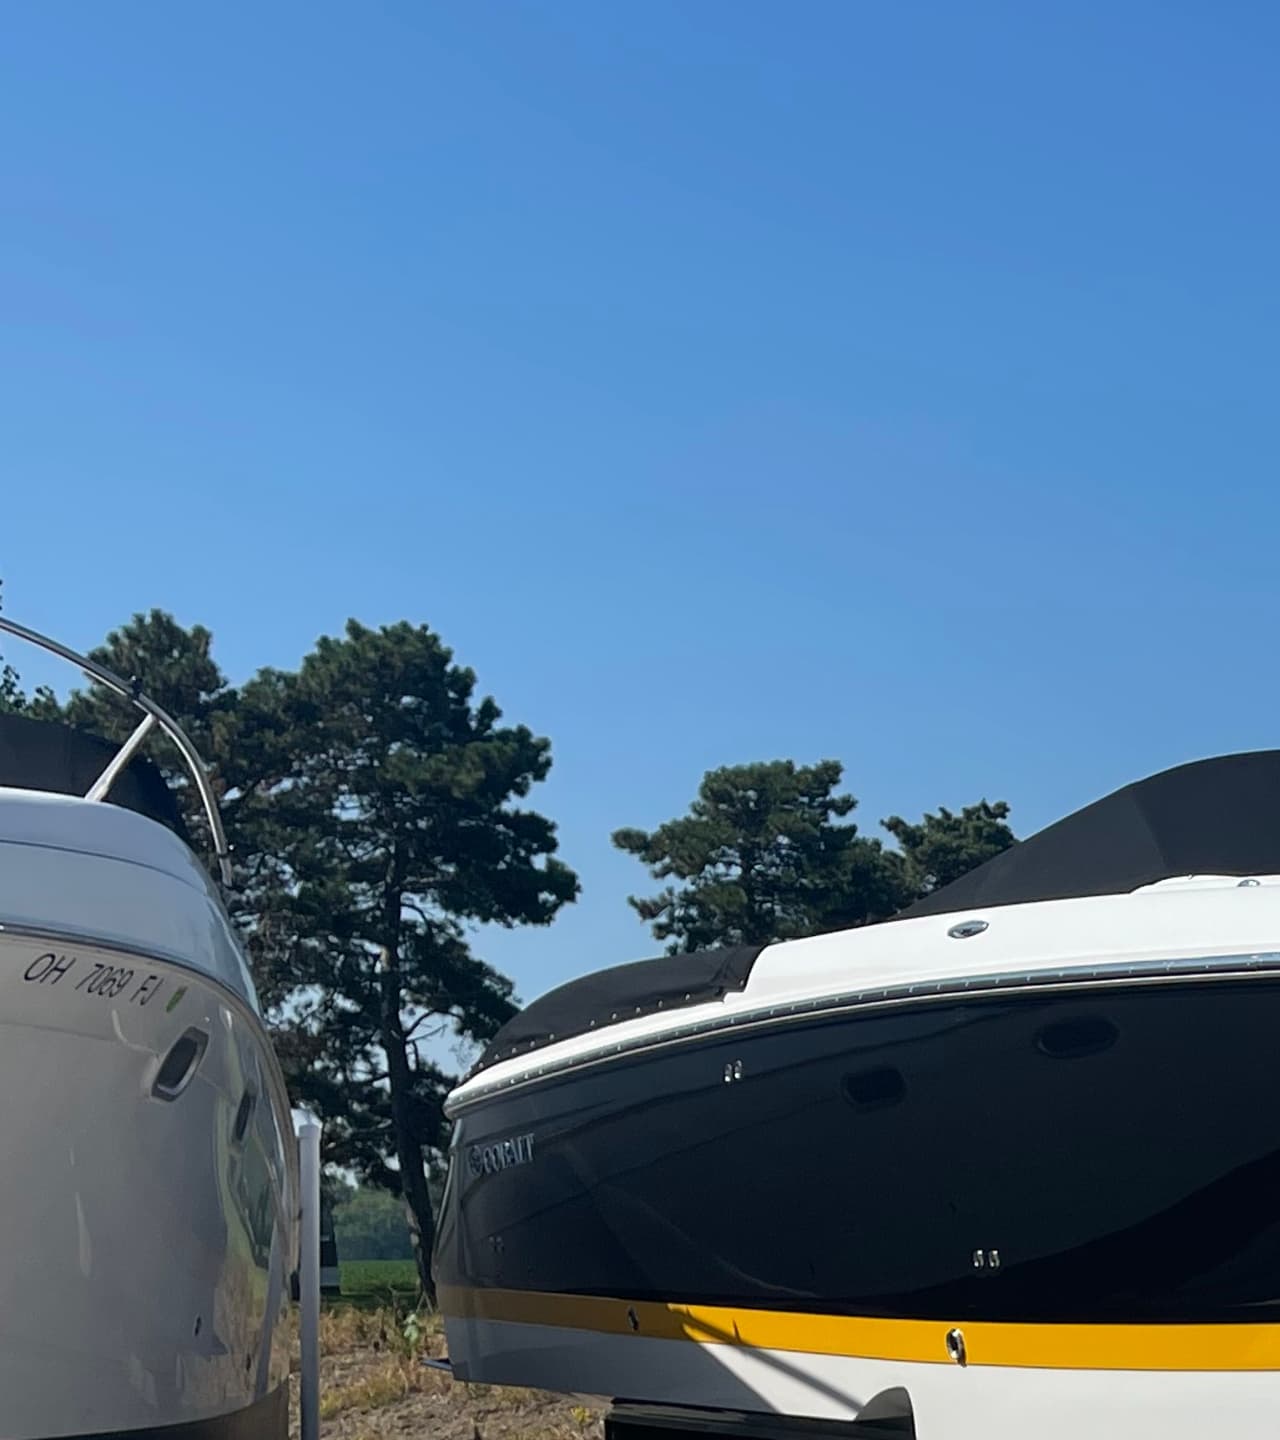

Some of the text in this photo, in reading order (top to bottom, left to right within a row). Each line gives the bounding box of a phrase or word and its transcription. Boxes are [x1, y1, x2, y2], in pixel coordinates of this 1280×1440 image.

[24, 953, 165, 1006] OH 7069 FJ
